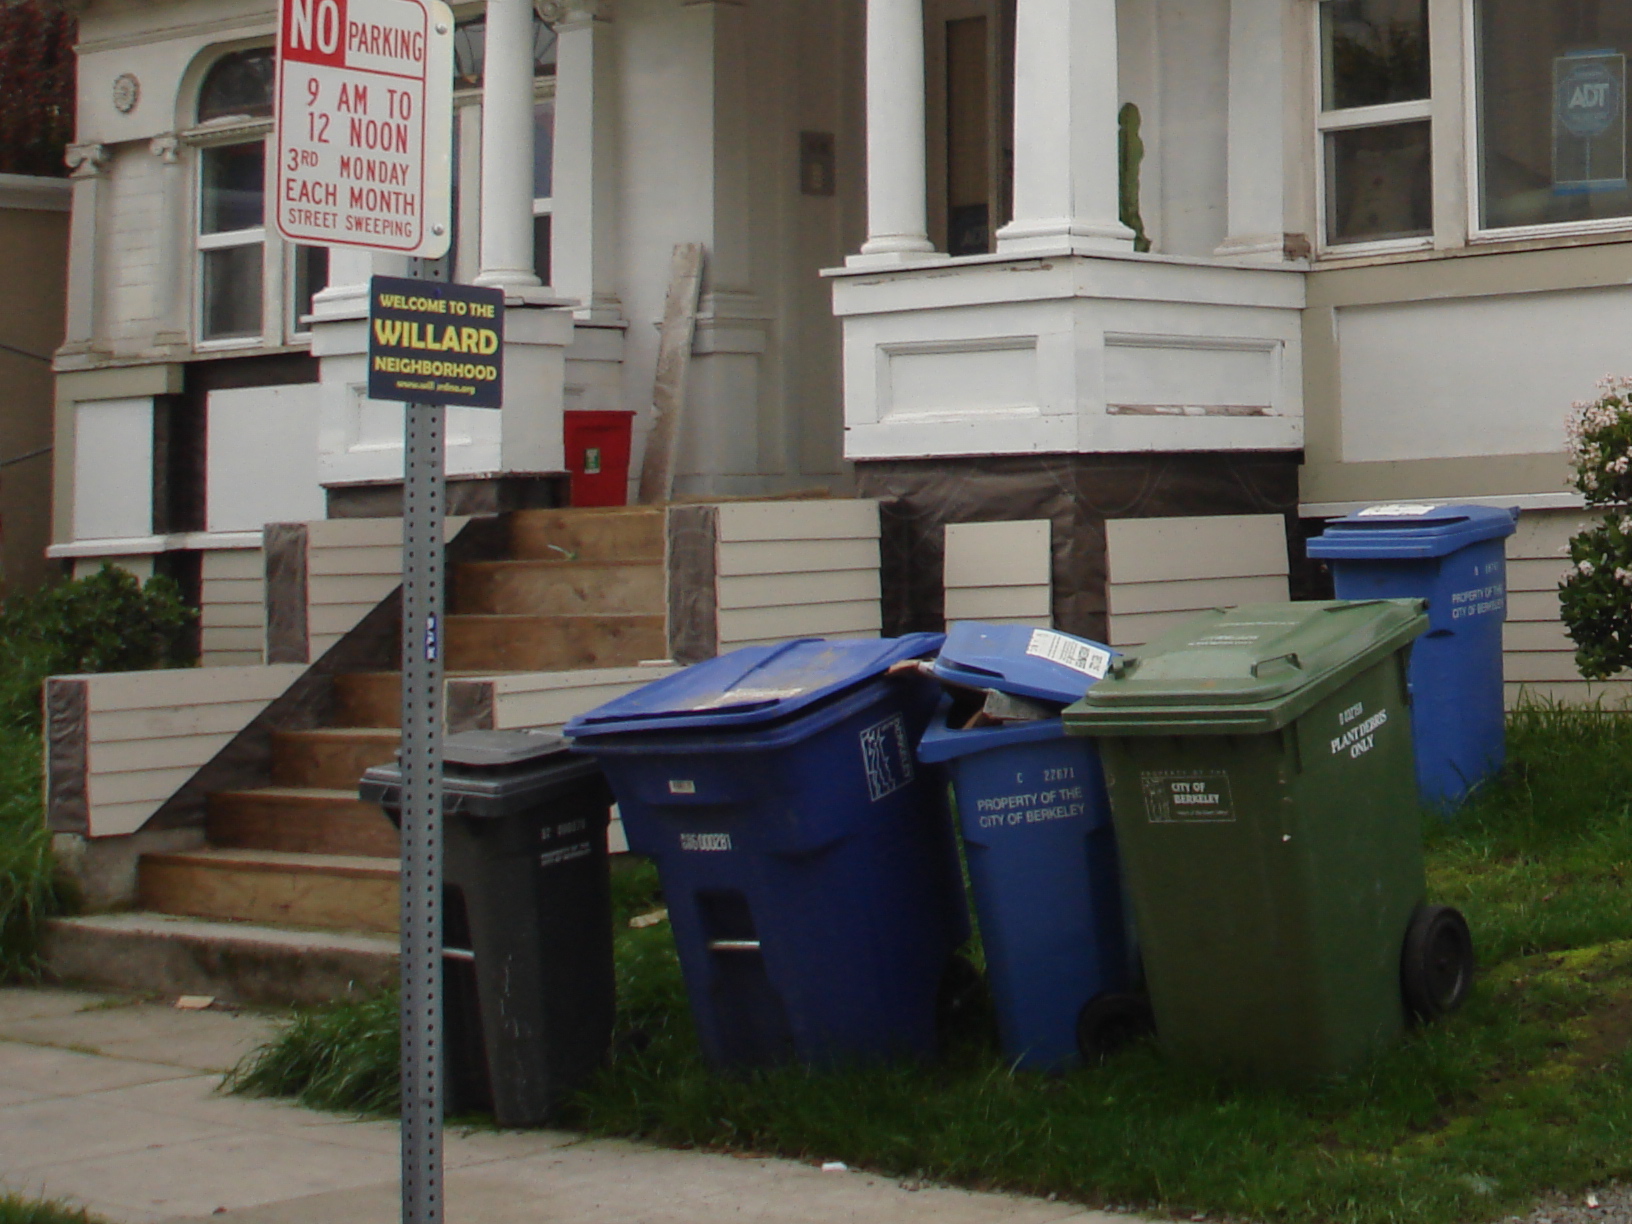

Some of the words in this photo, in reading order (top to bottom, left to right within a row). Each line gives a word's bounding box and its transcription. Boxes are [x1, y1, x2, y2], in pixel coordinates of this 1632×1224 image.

[348, 19, 424, 63] PARKING
[307, 78, 320, 107] 9
[337, 82, 368, 116] AM
[387, 89, 412, 121] TO
[1568, 83, 1609, 109] ADT
[308, 112, 330, 144] 12
[350, 119, 408, 154] NOON
[286, 148, 319, 172] 3RD
[340, 155, 409, 187] MONDAY
[285, 179, 337, 207] EACH
[349, 186, 416, 217] MONTH
[288, 208, 338, 231] STREET
[345, 214, 413, 239] SWEEPING
[380, 292, 447, 314] WELCOME
[449, 300, 467, 316] TO
[470, 301, 496, 318] THE
[374, 318, 498, 356] WILLARD
[374, 356, 498, 381] NEIGHBORHOOD
[1452, 606, 1467, 619] CITY
[1331, 727, 1359, 755] PLANT
[1359, 708, 1388, 738] DEBRIS
[1350, 734, 1374, 759] ONLY
[976, 792, 1038, 812] PROPERTY
[1040, 790, 1058, 804] OF
[1058, 786, 1084, 801] THE
[1171, 782, 1191, 793] CITY
[1192, 782, 1206, 793] OF
[1173, 793, 1220, 805] BERKELEY
[979, 813, 1006, 829] CITY
[1007, 811, 1024, 826] OF
[1025, 802, 1086, 823] BERKELEY
